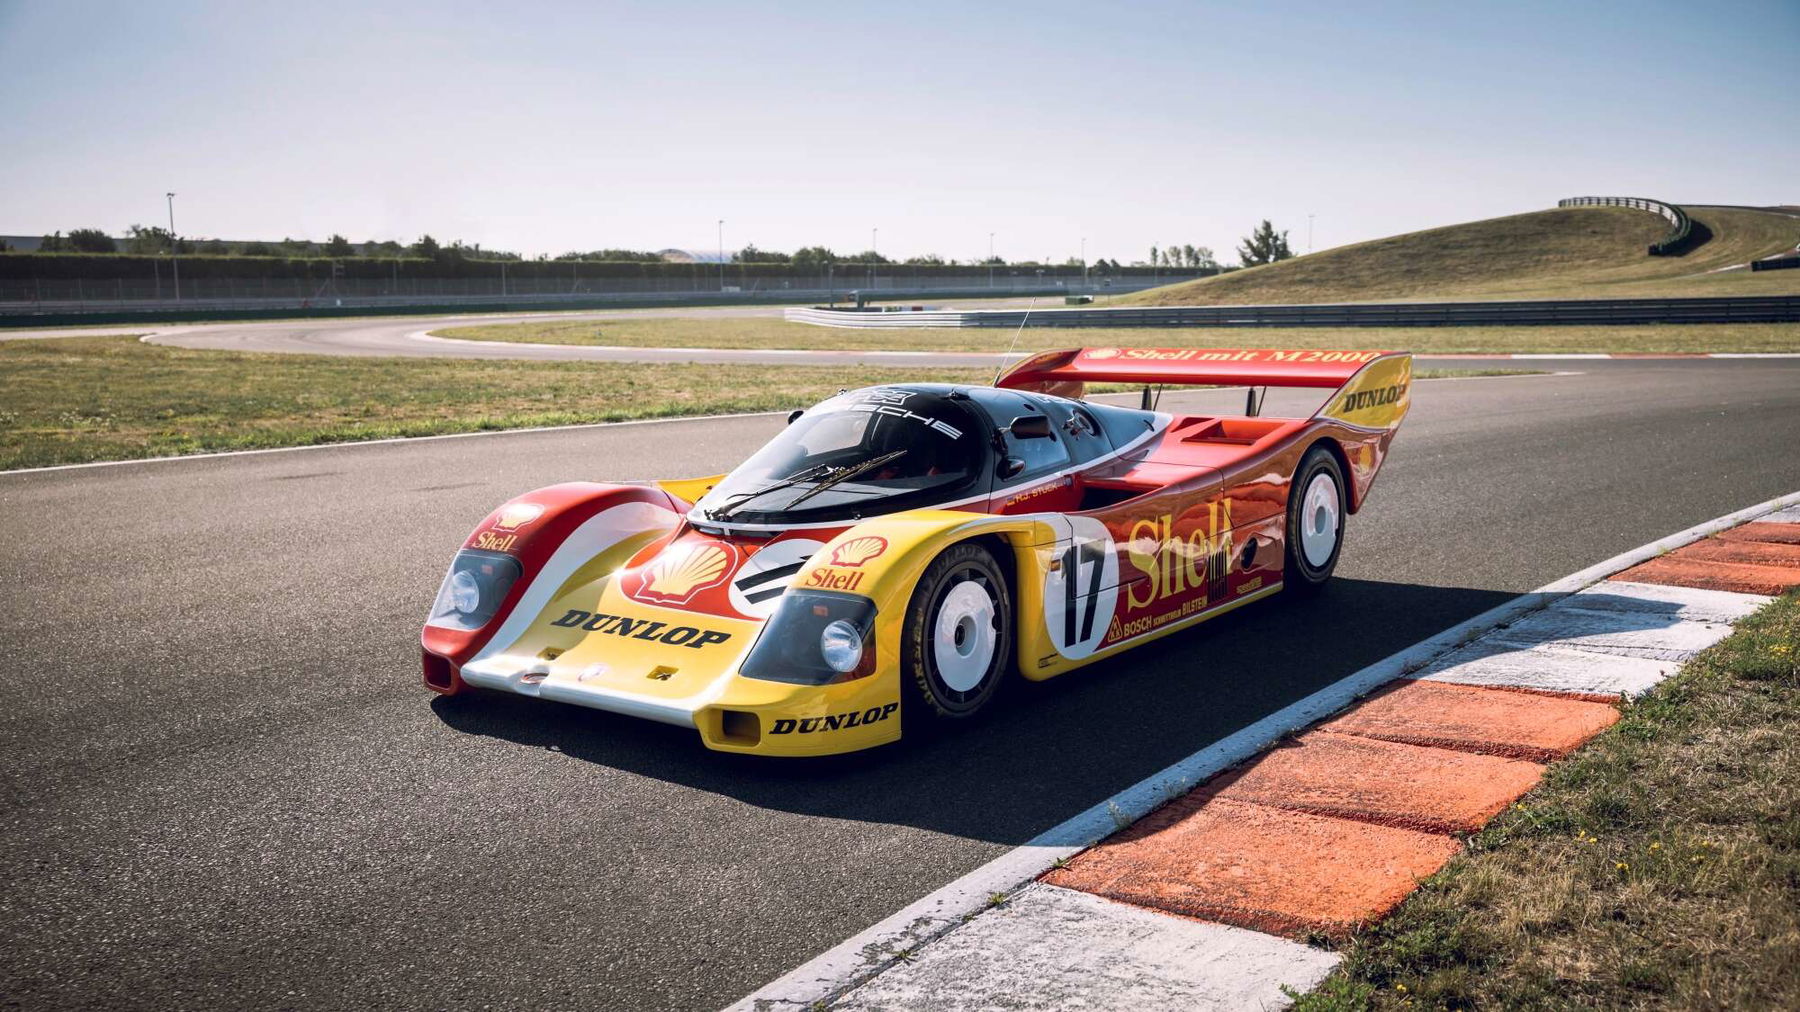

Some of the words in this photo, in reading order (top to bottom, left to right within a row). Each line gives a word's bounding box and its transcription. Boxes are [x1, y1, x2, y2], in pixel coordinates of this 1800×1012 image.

[1119, 349, 1199, 360] Shell
[1198, 350, 1259, 361] mit
[1343, 384, 1406, 413] DUNLOP
[1032, 482, 1058, 497] STUCK
[472, 531, 518, 552] Shell
[1127, 498, 1234, 613] Shell
[805, 568, 864, 591] Shell
[1062, 538, 1106, 648] 17
[550, 609, 732, 649] DUNLOP
[1123, 615, 1153, 637] BOSCH
[1182, 594, 1208, 616] BILSTEIN
[768, 702, 899, 735] DUNLOP
